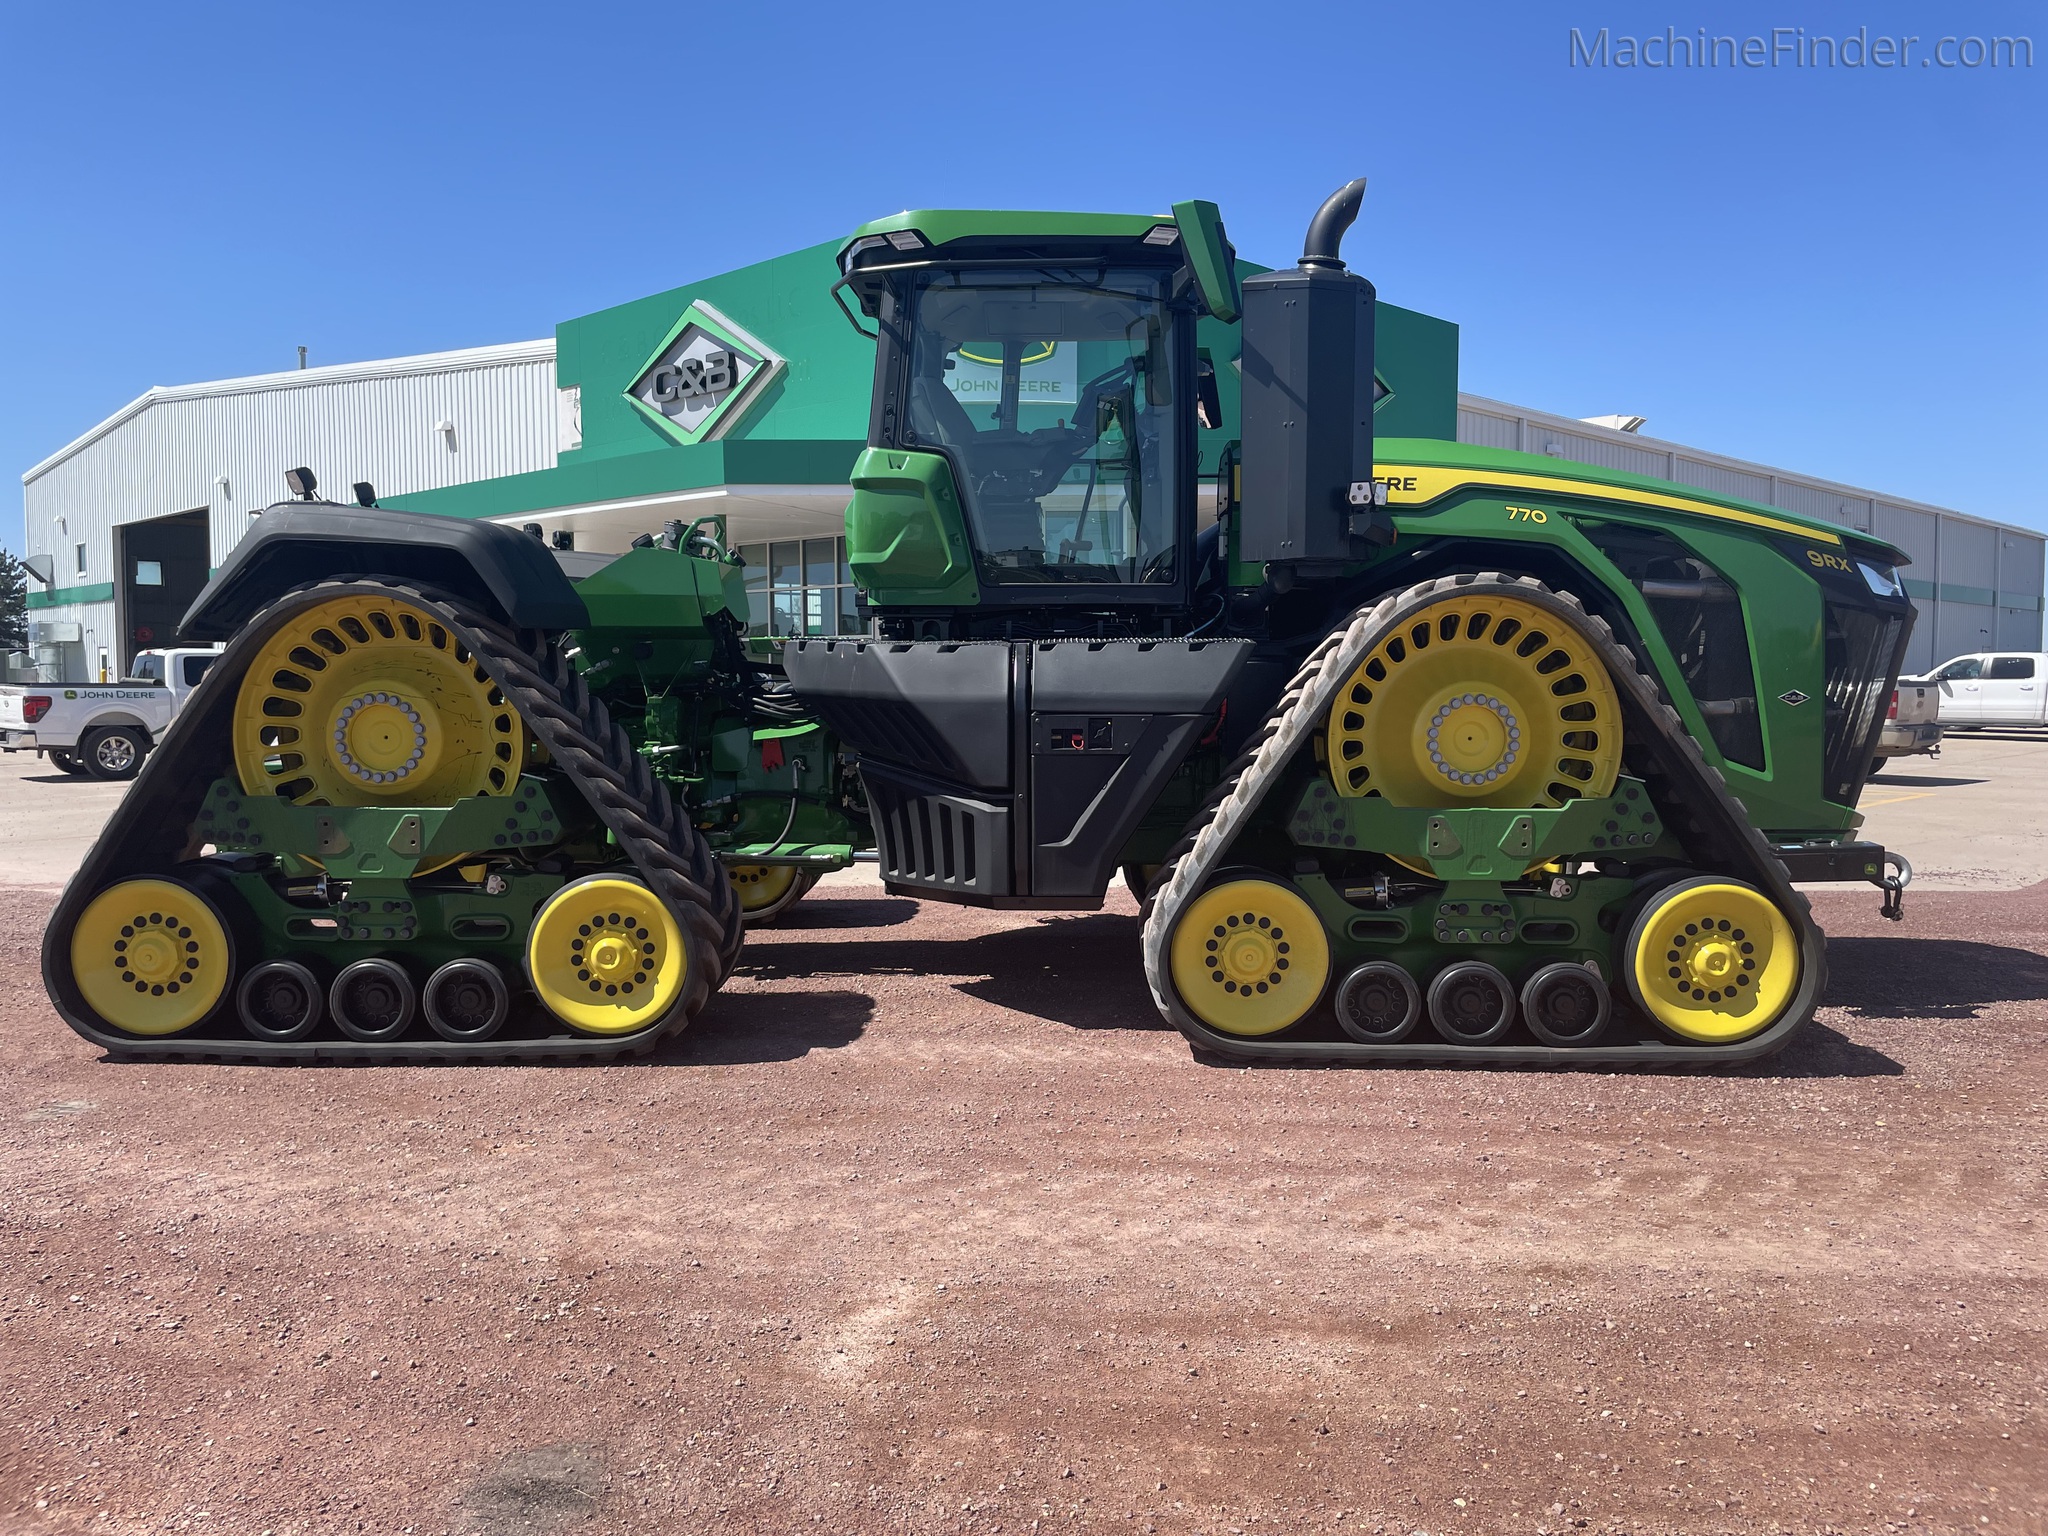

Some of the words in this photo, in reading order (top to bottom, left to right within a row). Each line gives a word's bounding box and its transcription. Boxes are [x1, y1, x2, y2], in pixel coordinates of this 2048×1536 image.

[652, 351, 734, 402] C&B
[951, 378, 999, 392] JOHN
[1019, 380, 1062, 393] EERE
[1505, 506, 1548, 524] 770
[1806, 550, 1853, 573] 9RX
[80, 690, 113, 699] JOHN
[116, 690, 156, 699] DEERE
